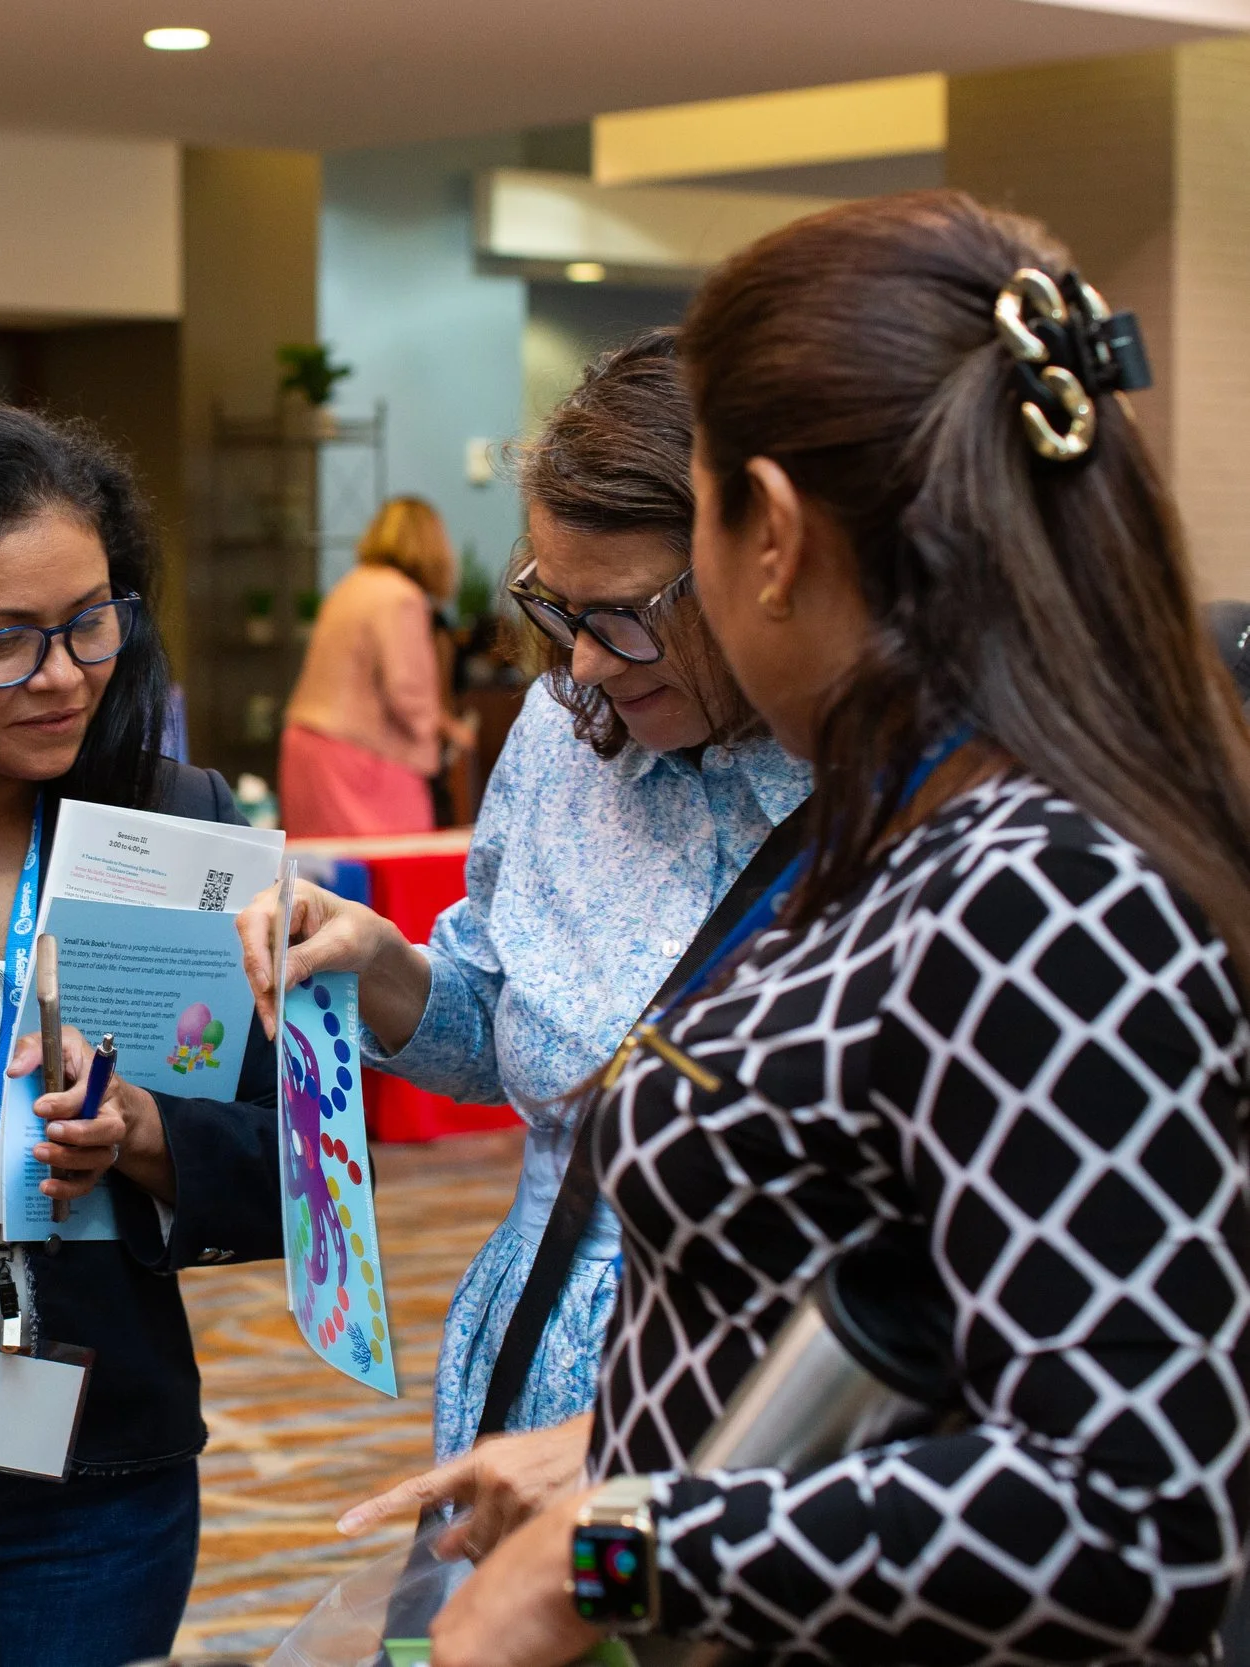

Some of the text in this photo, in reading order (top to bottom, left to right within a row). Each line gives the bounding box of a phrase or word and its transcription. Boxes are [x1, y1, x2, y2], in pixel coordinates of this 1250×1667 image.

[117, 832, 140, 842] Session
[128, 844, 140, 852] 4:00
[18, 882, 32, 918] gaeyc
[132, 945, 148, 953] young
[77, 950, 90, 959] story,
[191, 960, 222, 968] understanding
[96, 963, 108, 972] daily
[118, 965, 141, 974] Frequent
[188, 970, 196, 978] big
[196, 971, 214, 979] learning
[84, 984, 96, 992] time.
[98, 985, 114, 994] Daddy
[163, 991, 181, 999] putting
[100, 997, 114, 1005] teddy
[115, 998, 130, 1006] bears,
[124, 1010, 142, 1018] having
[347, 1002, 357, 1045] AGES
[114, 1032, 132, 1040] phrases
